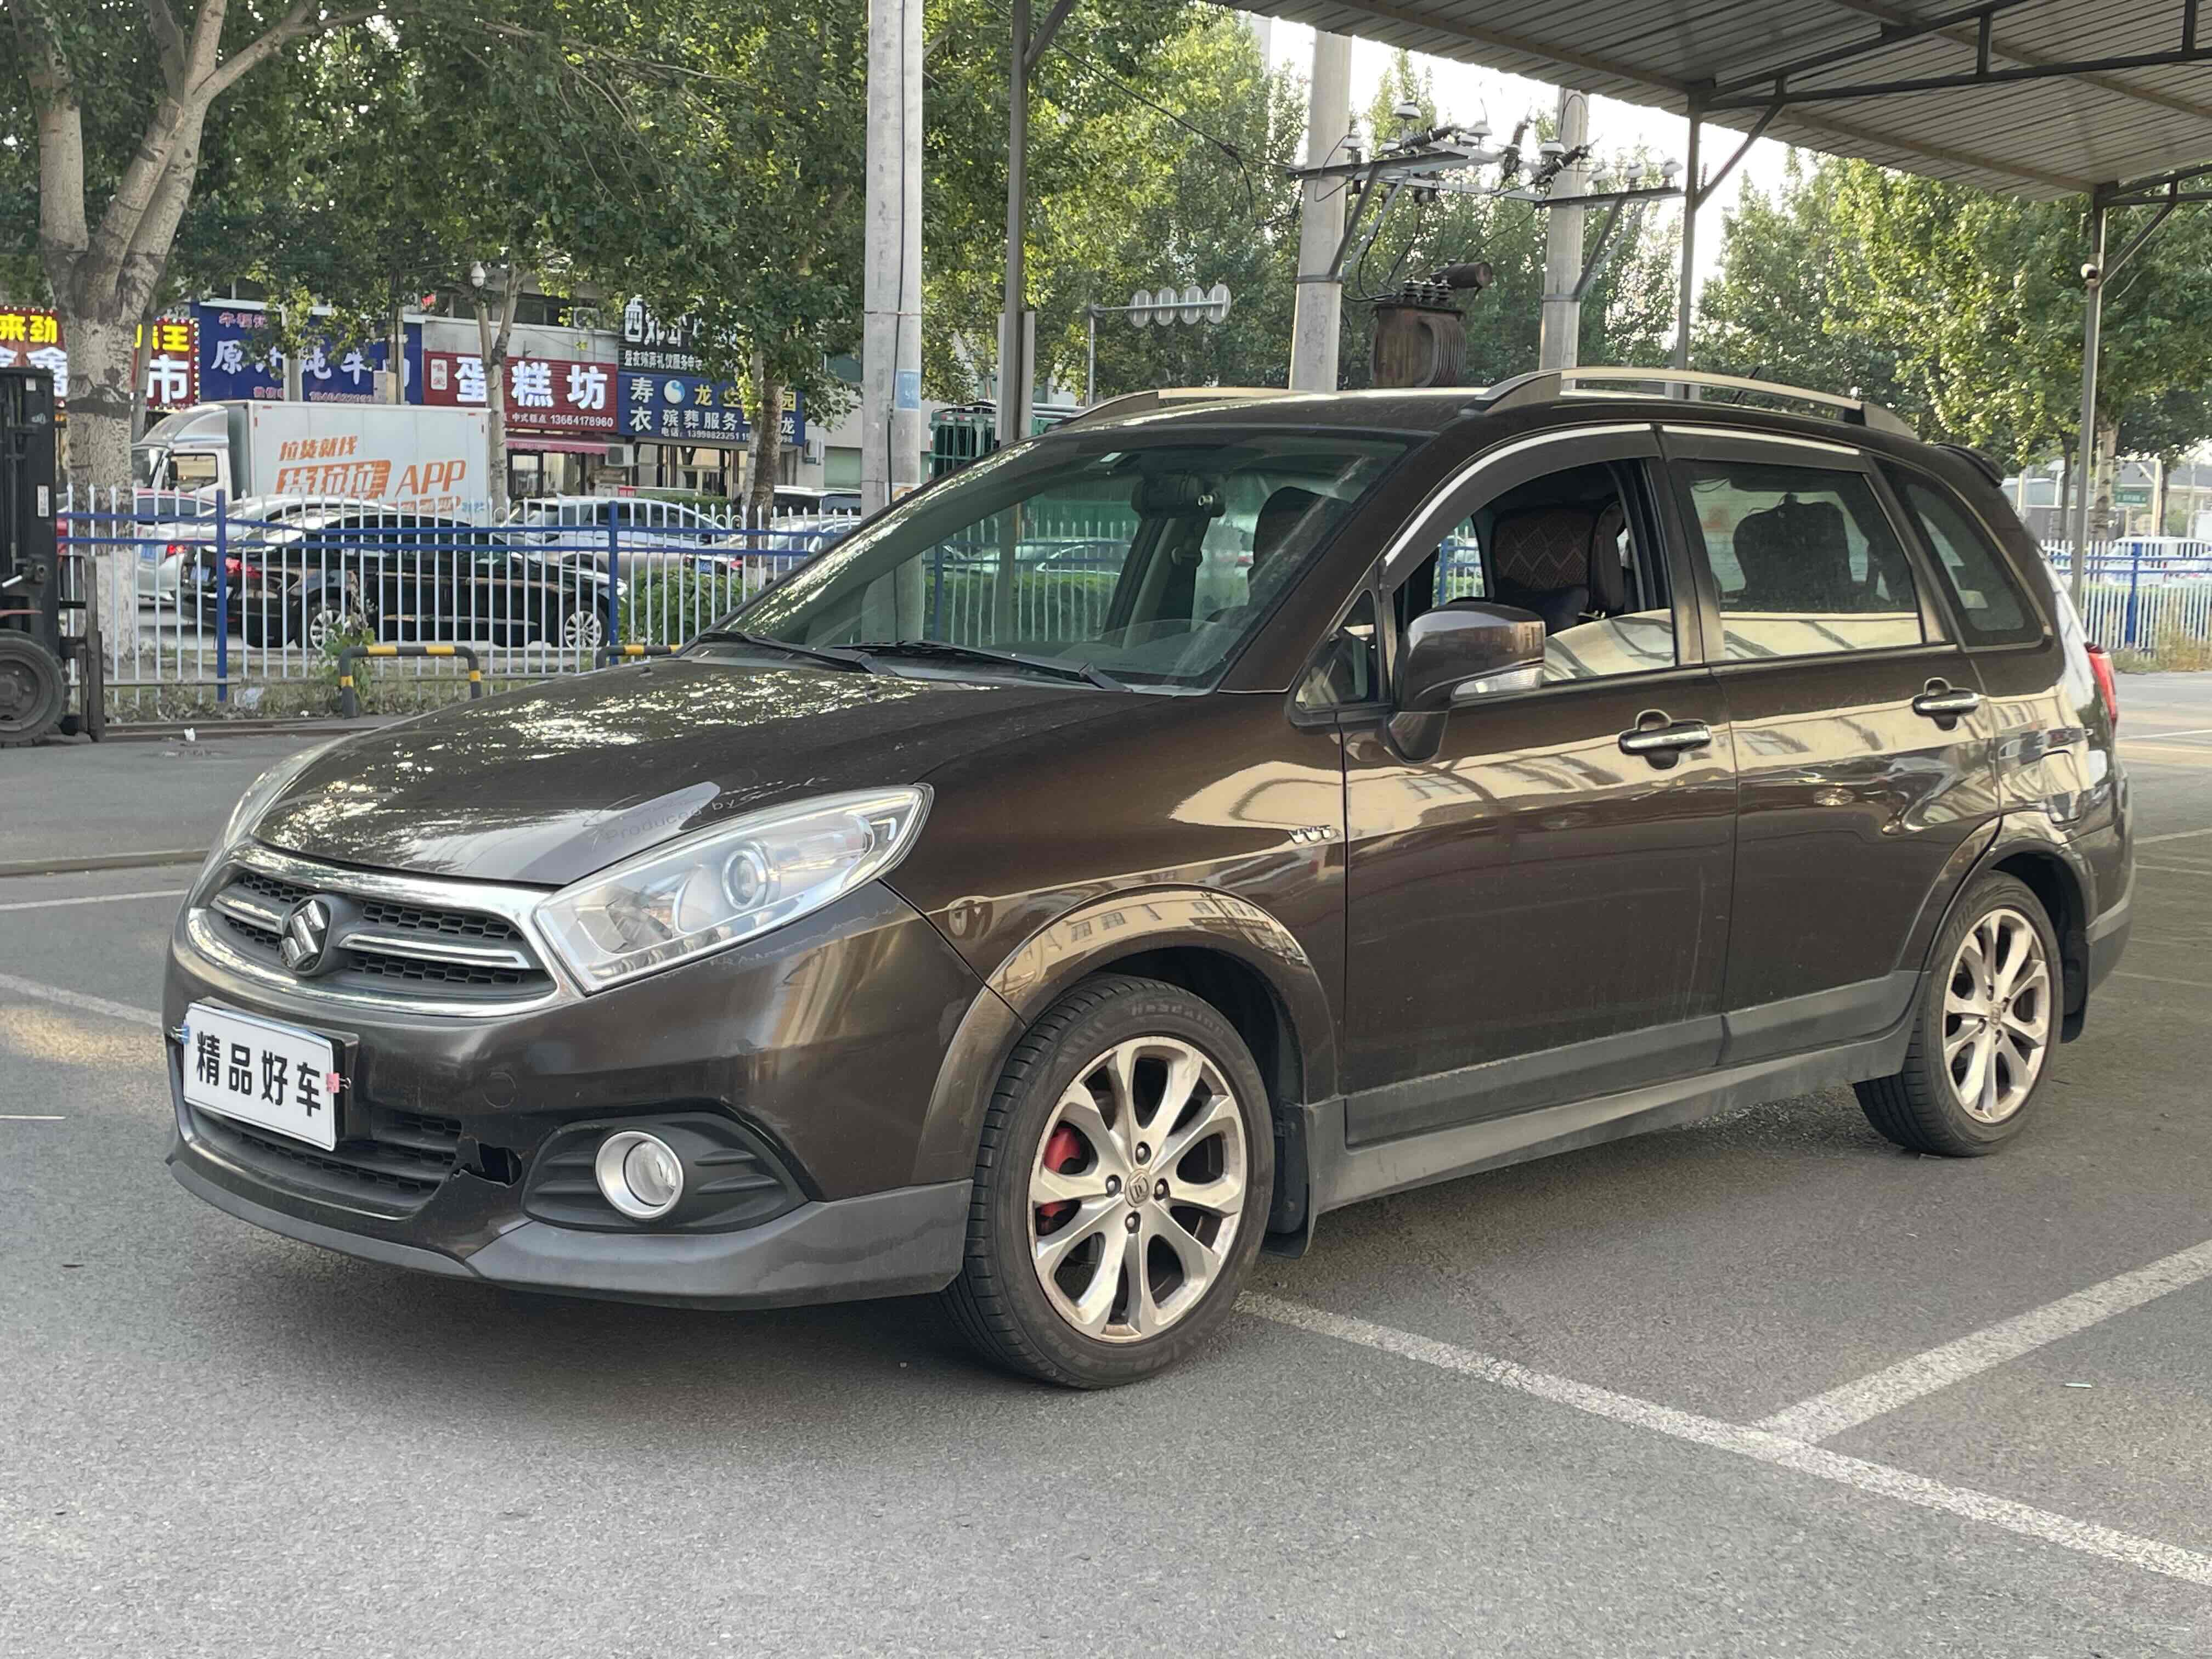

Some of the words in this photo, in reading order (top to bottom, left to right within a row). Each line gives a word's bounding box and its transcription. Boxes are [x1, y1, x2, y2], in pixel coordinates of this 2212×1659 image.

[454, 356, 608, 410] 蛋糕坊
[630, 377, 654, 431] 寿衣
[662, 409, 795, 435] 殡葬服务一龙
[279, 435, 358, 460] 拉货就找
[394, 460, 466, 496] APP
[605, 805, 702, 843] Produced
[196, 1030, 322, 1118] 精品好车
